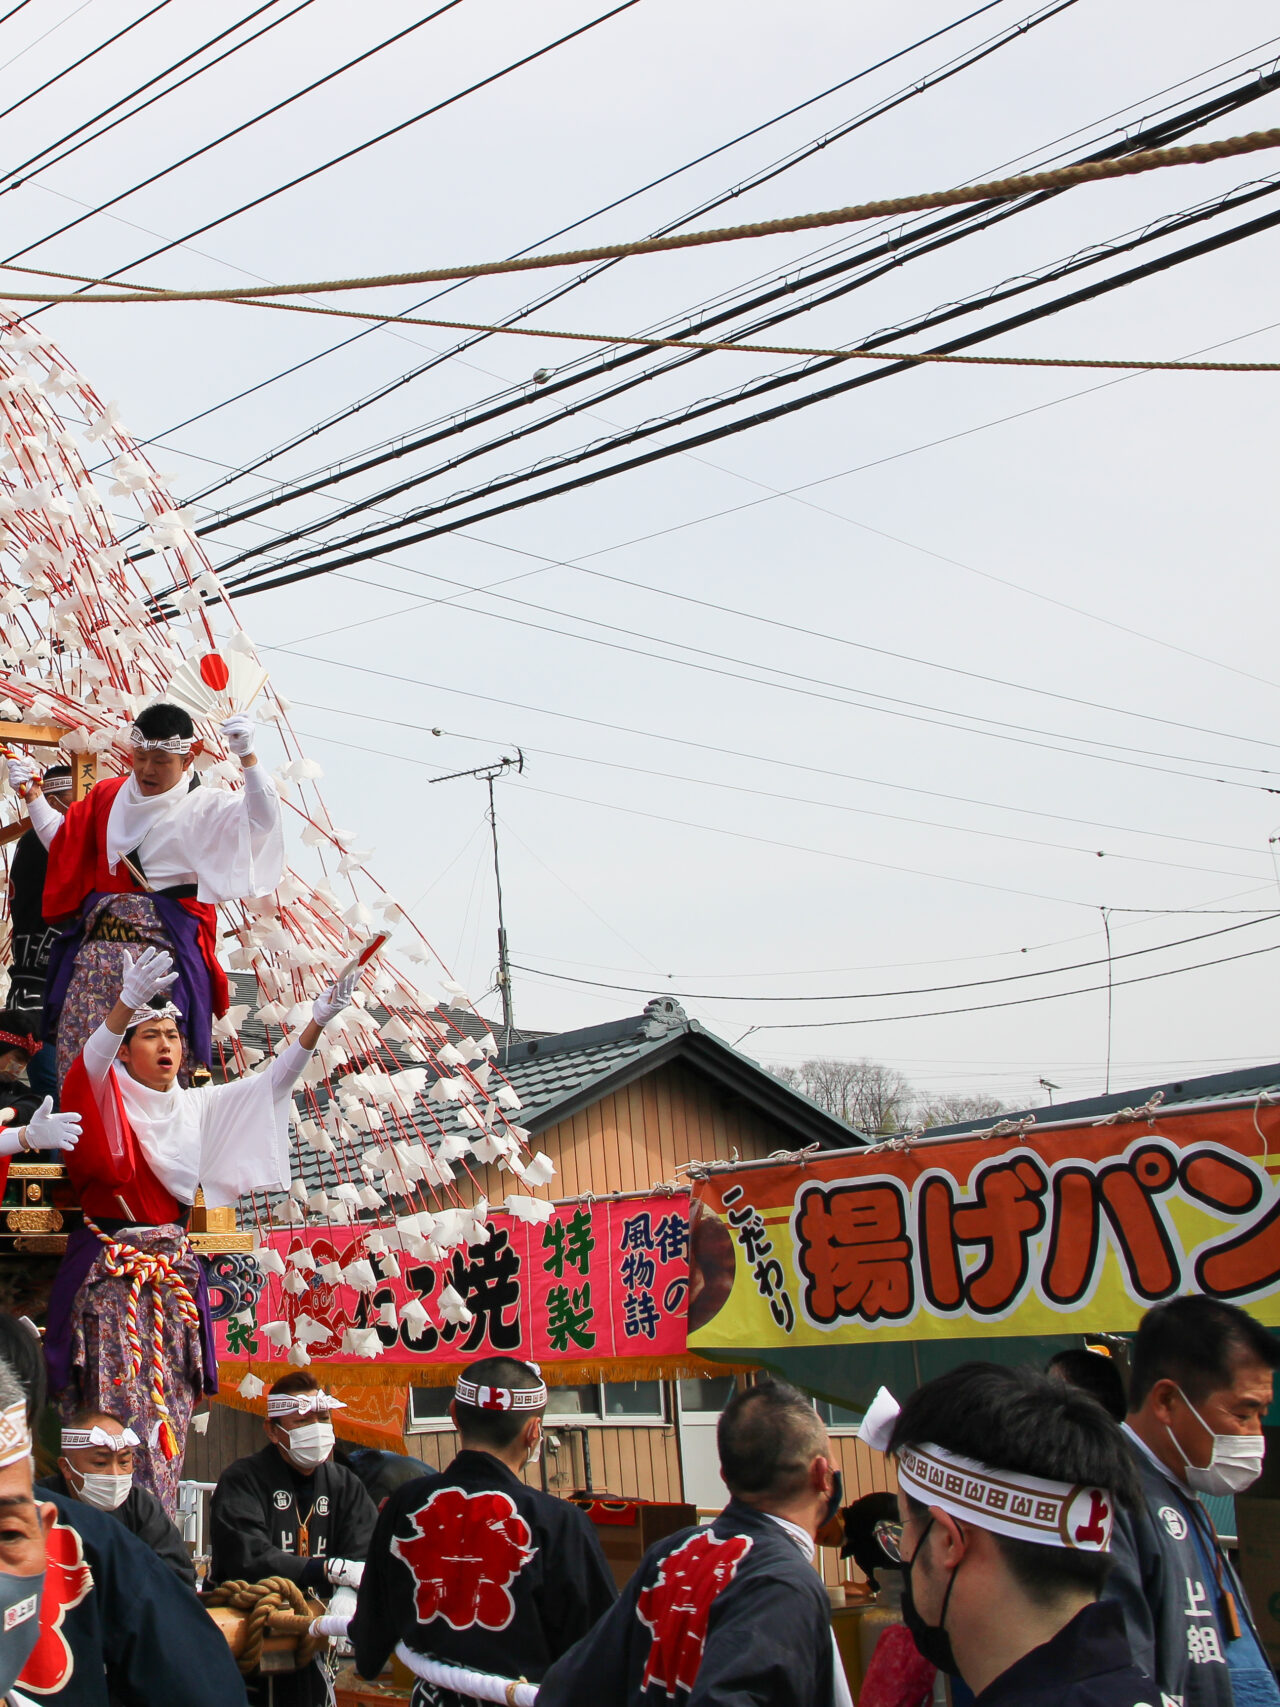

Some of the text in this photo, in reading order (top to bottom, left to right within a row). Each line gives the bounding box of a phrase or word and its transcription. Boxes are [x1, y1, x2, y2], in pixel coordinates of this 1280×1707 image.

[81, 763, 95, 794] 天下
[541, 1208, 596, 1352] 特製
[619, 1211, 662, 1340] 風物詩
[654, 1211, 690, 1318] 街の
[721, 1184, 796, 1335] こだわり
[792, 1138, 1280, 1328] 揚げパン
[1184, 1577, 1226, 1664] 上組
